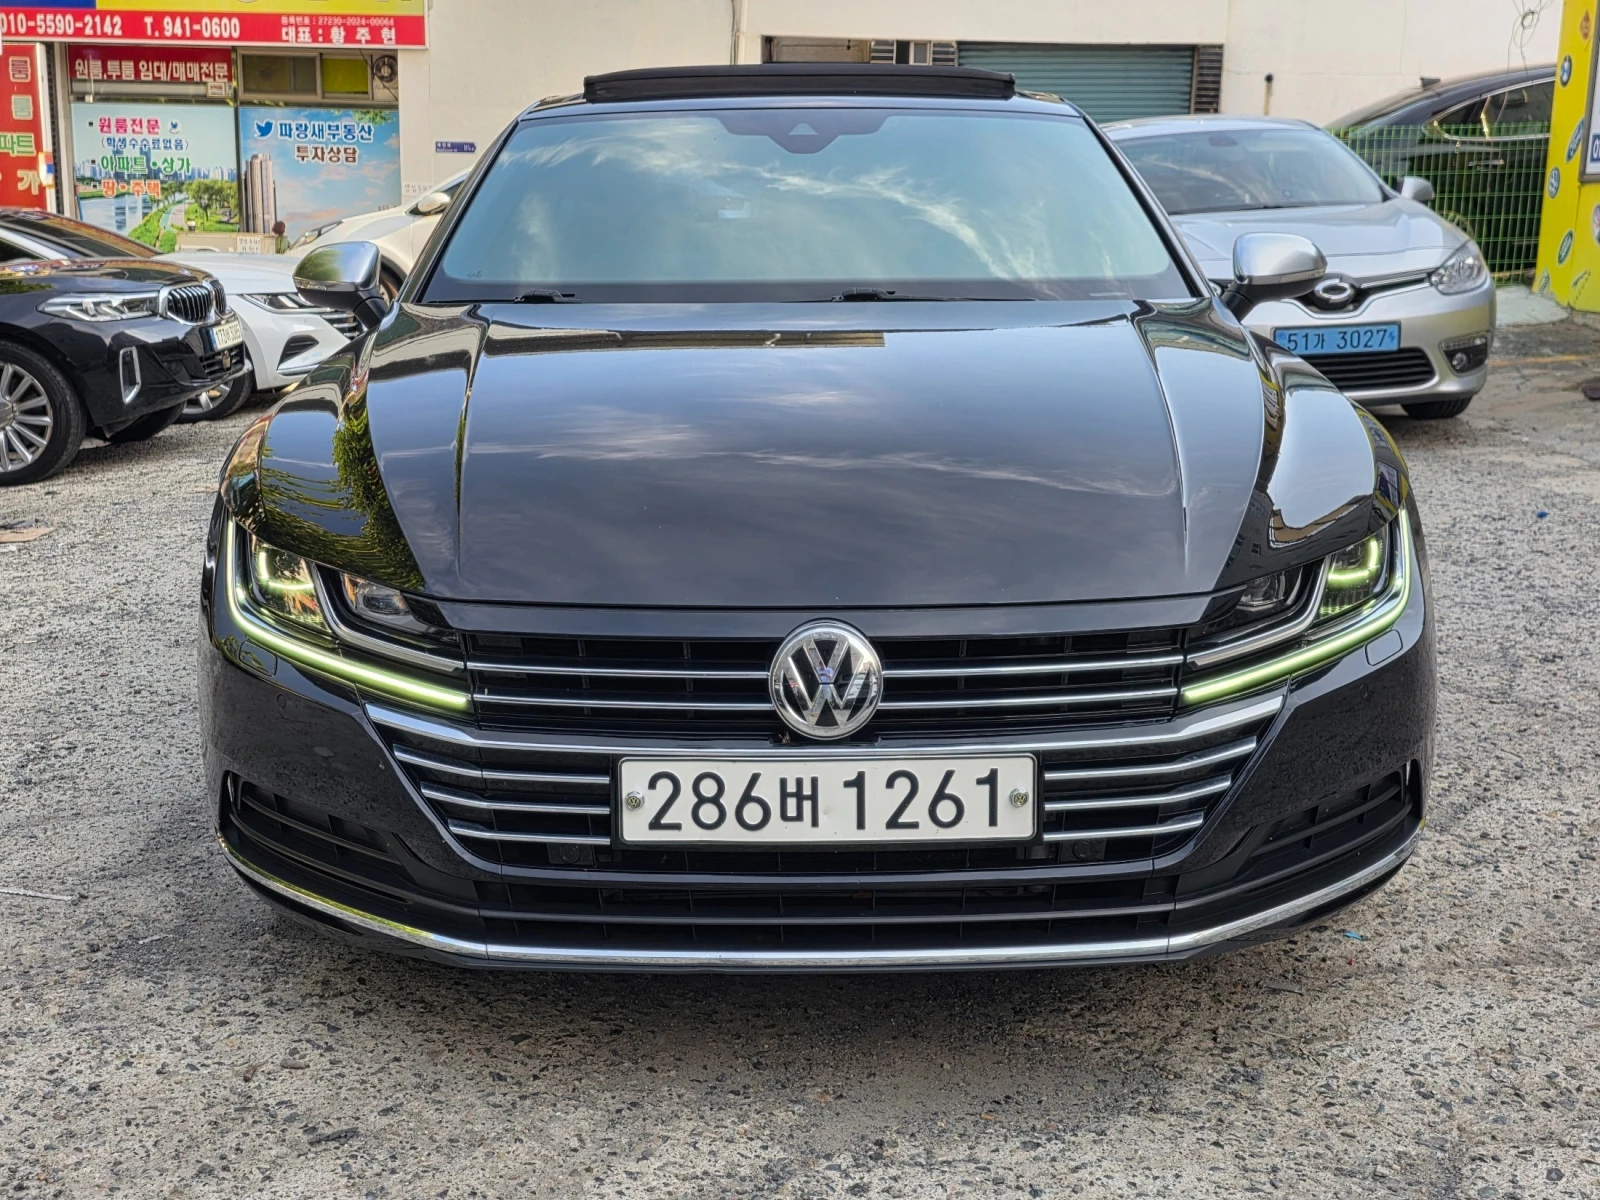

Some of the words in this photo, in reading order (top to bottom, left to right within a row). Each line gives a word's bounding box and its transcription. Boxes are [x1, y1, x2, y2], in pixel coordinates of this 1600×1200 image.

[0, 13, 122, 35] 010-5590-2142
[281, 26, 312, 43] 대표
[138, 60, 229, 83] 임대/매매전문
[98, 116, 161, 135] 원룸전문
[278, 121, 375, 143] 파랑새부동산
[101, 136, 190, 151] (학생수수료없음)
[295, 144, 359, 165] 투자상담
[1287, 333, 1325, 352] 51가
[1336, 329, 1388, 350] 3027
